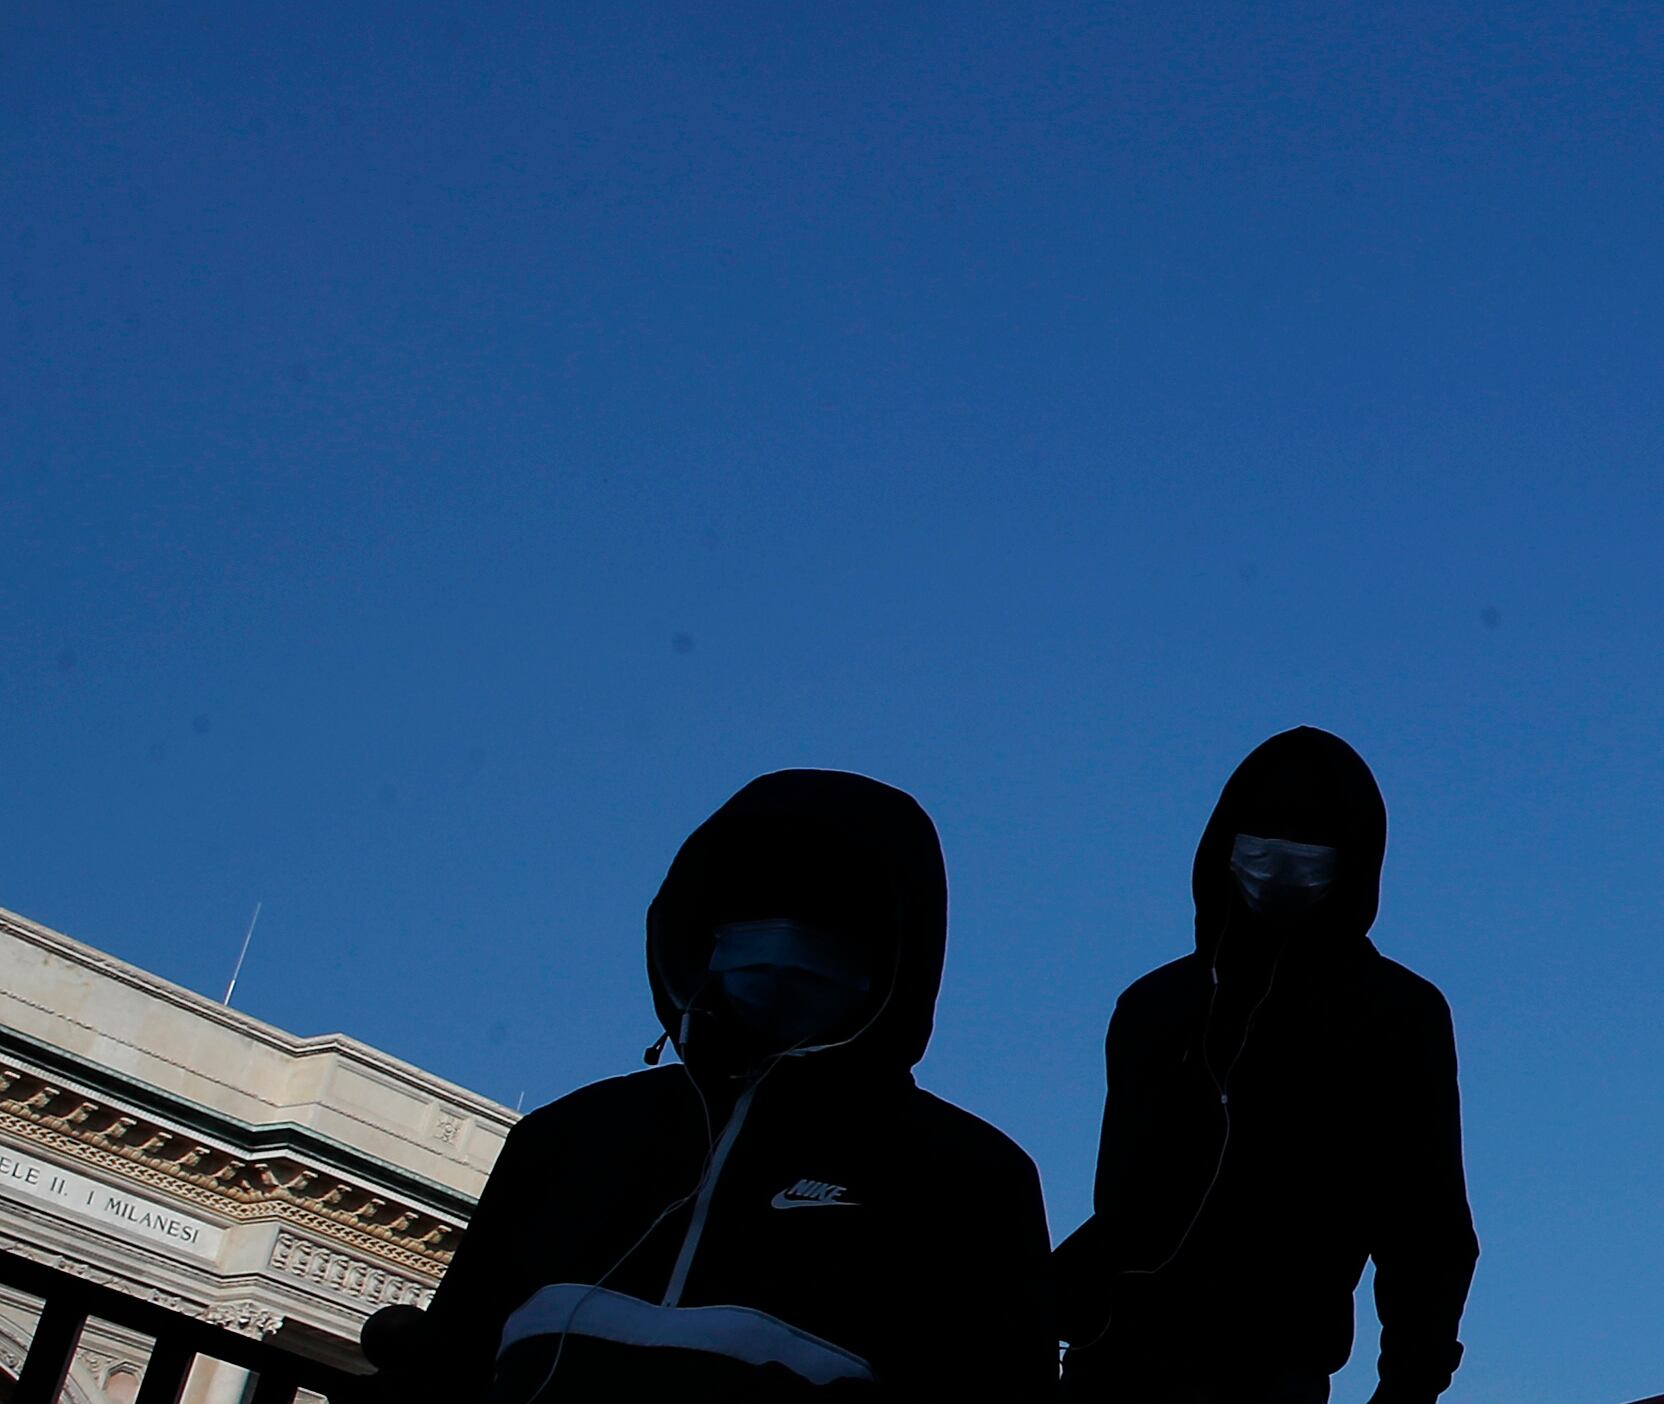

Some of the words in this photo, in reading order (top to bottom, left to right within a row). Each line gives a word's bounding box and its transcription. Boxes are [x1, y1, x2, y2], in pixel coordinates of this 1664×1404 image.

[788, 1178, 848, 1201] NIKE
[87, 1191, 95, 1205] I
[103, 1197, 201, 1245] MILANESI
